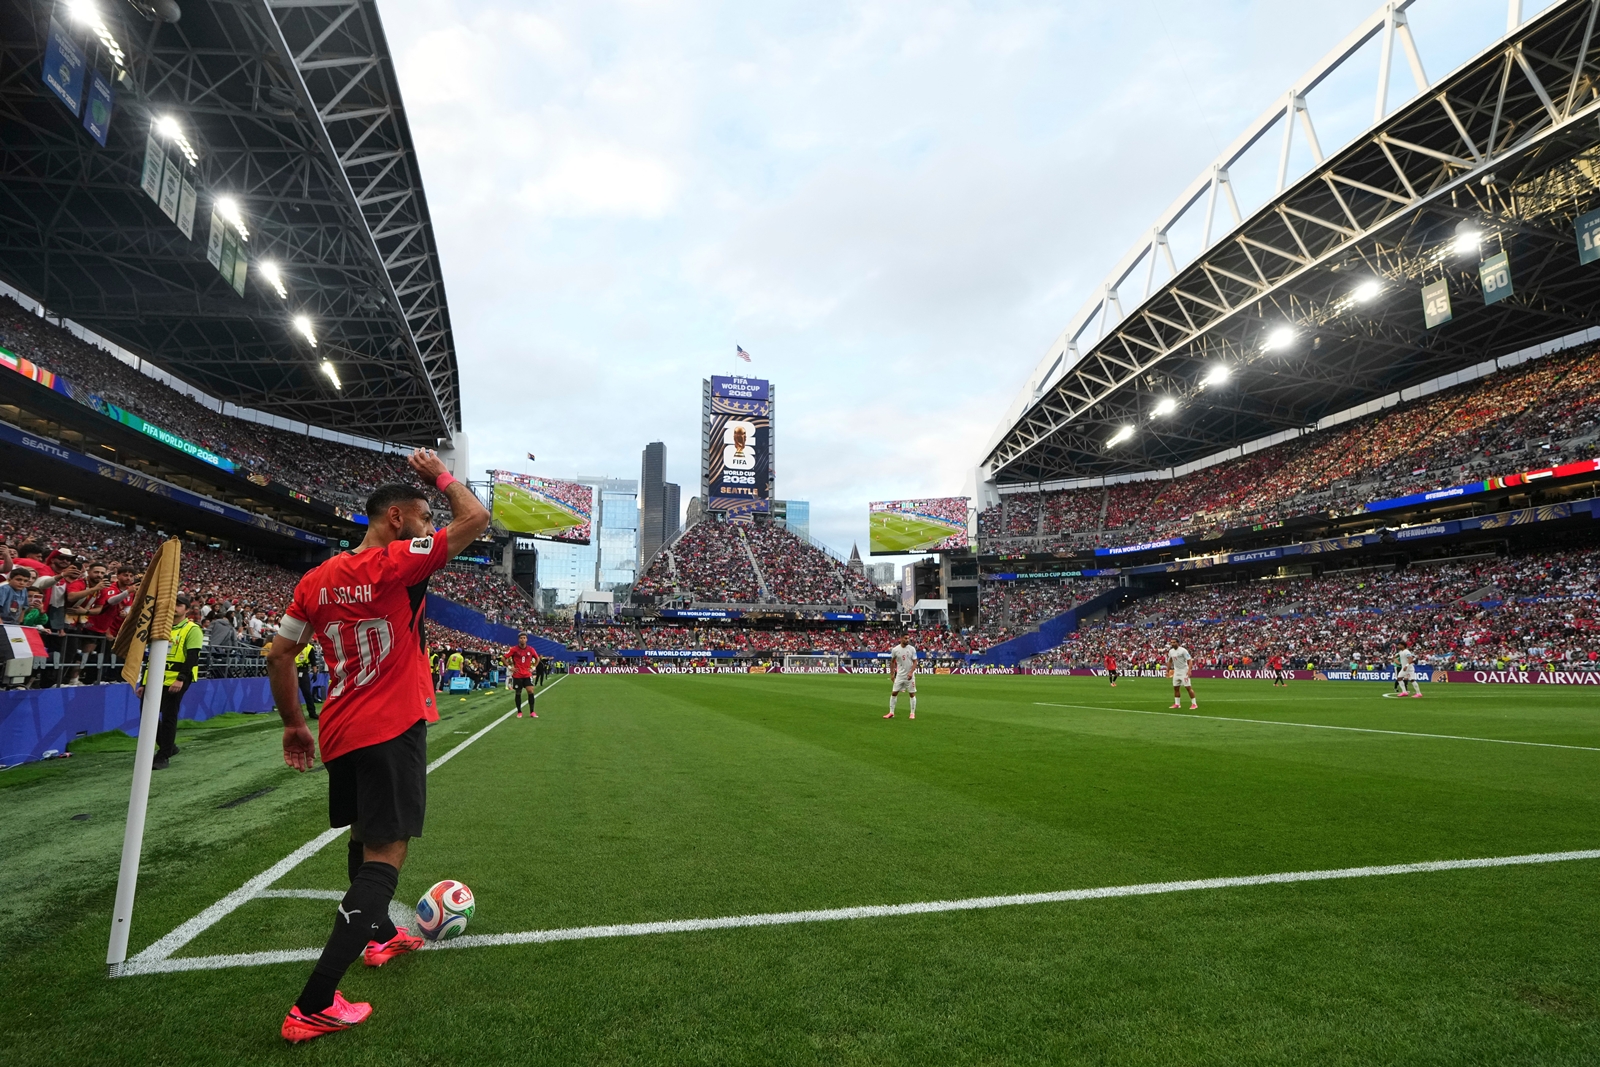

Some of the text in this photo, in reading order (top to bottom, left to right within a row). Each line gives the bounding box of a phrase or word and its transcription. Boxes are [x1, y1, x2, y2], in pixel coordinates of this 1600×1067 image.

[1484, 270, 1508, 293] 80
[1426, 296, 1448, 316] 45
[22, 436, 70, 460] SEATTLE
[143, 422, 219, 465] FIFA WORLD CUP 2026
[723, 476, 756, 484] 2026
[720, 487, 758, 496] SEATTLE
[1397, 525, 1446, 538] #FIFAWorldCup
[305, 534, 326, 544] SEATTLE
[1233, 550, 1276, 561] SEATTLE
[333, 584, 372, 604] SALAH
[324, 614, 394, 700] 10
[573, 666, 602, 674] QATAR
[1223, 670, 1252, 679] QATAR
[1327, 672, 1351, 680] UNITED
[1380, 672, 1391, 680] OF
[1474, 671, 1530, 684] QATAR
